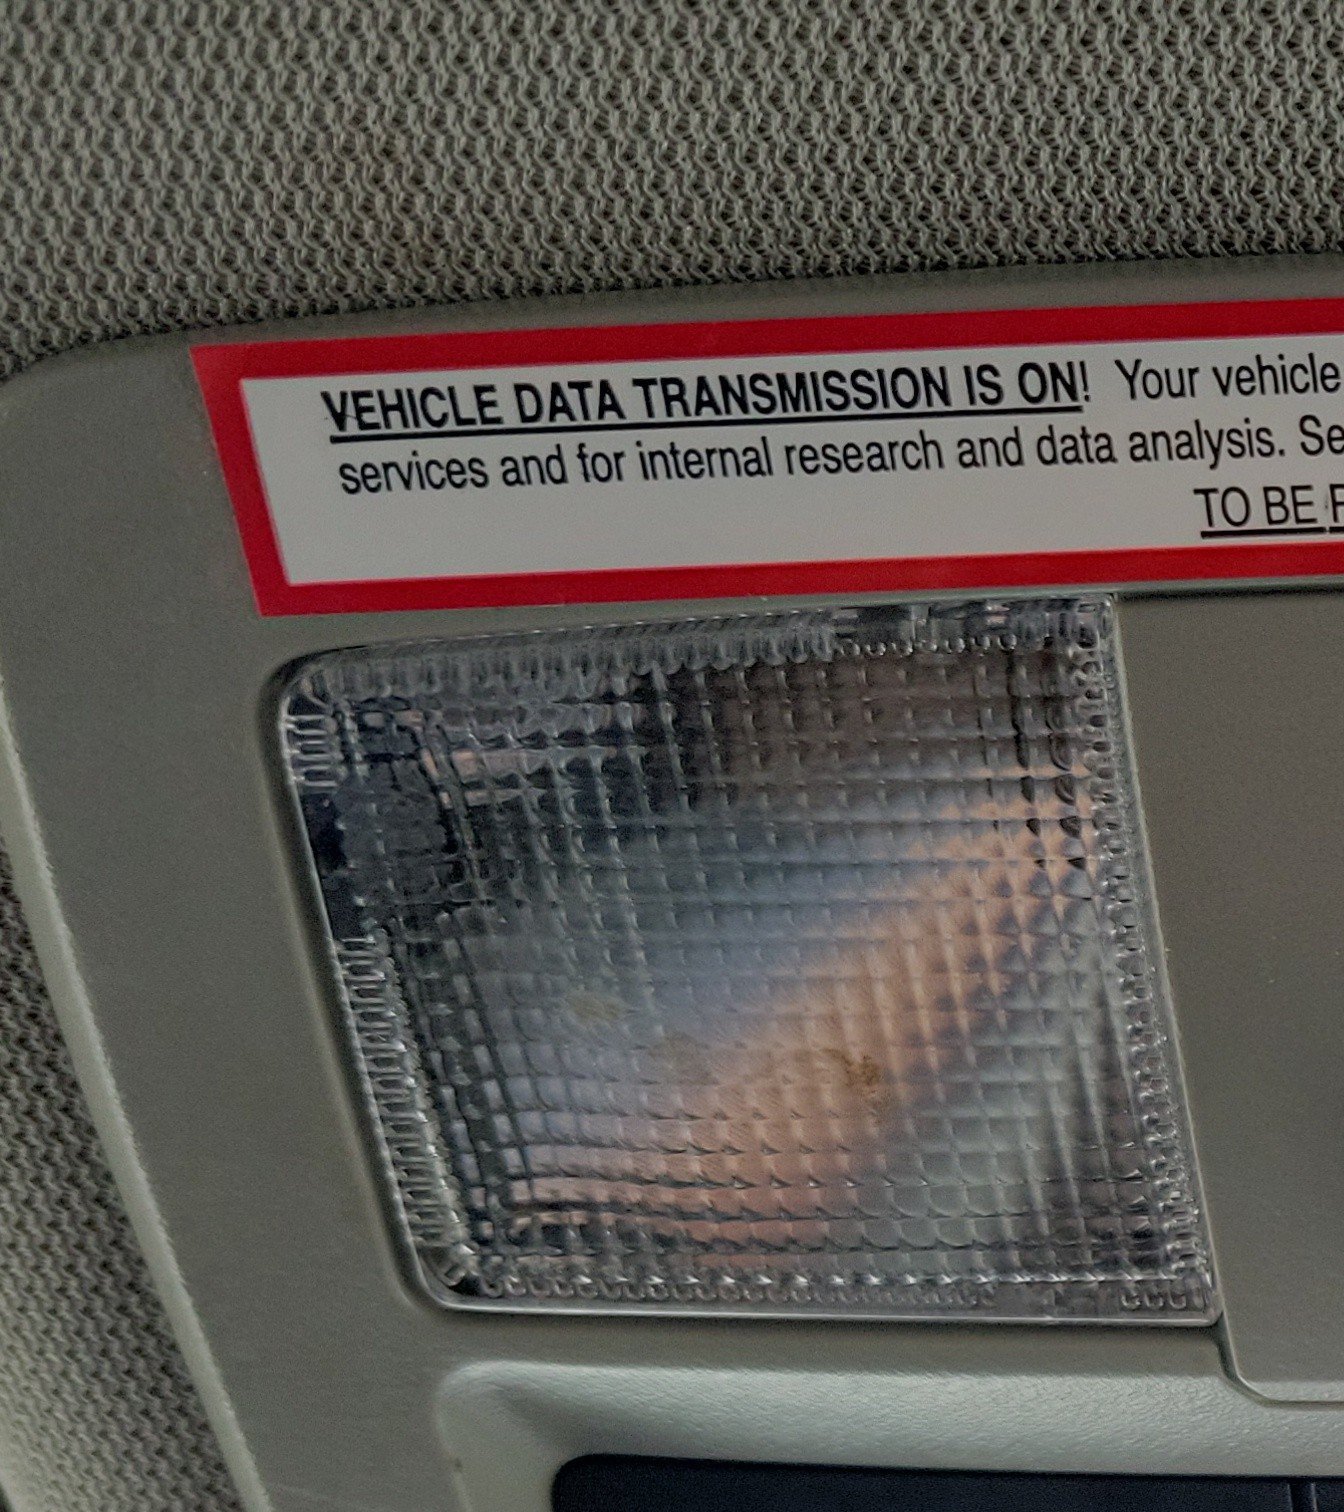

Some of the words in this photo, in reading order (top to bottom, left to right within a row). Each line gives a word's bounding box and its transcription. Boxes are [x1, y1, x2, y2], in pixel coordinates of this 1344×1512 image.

[322, 383, 504, 434] VEHICLE
[514, 377, 627, 425] DATA
[634, 366, 950, 420] TRANSMISSION
[962, 362, 1002, 406] IS
[1018, 361, 1090, 405] ON!
[1116, 360, 1199, 399] Your
[1212, 353, 1341, 395] vehicle
[338, 450, 490, 495] services
[502, 446, 569, 486] and
[577, 445, 627, 484] for
[636, 438, 774, 480] internal
[784, 430, 944, 475] research
[958, 427, 1025, 470] and
[1036, 426, 1116, 466] data
[1128, 420, 1286, 471] analysis.
[1194, 485, 1252, 530] TO
[1265, 482, 1317, 525] BE
